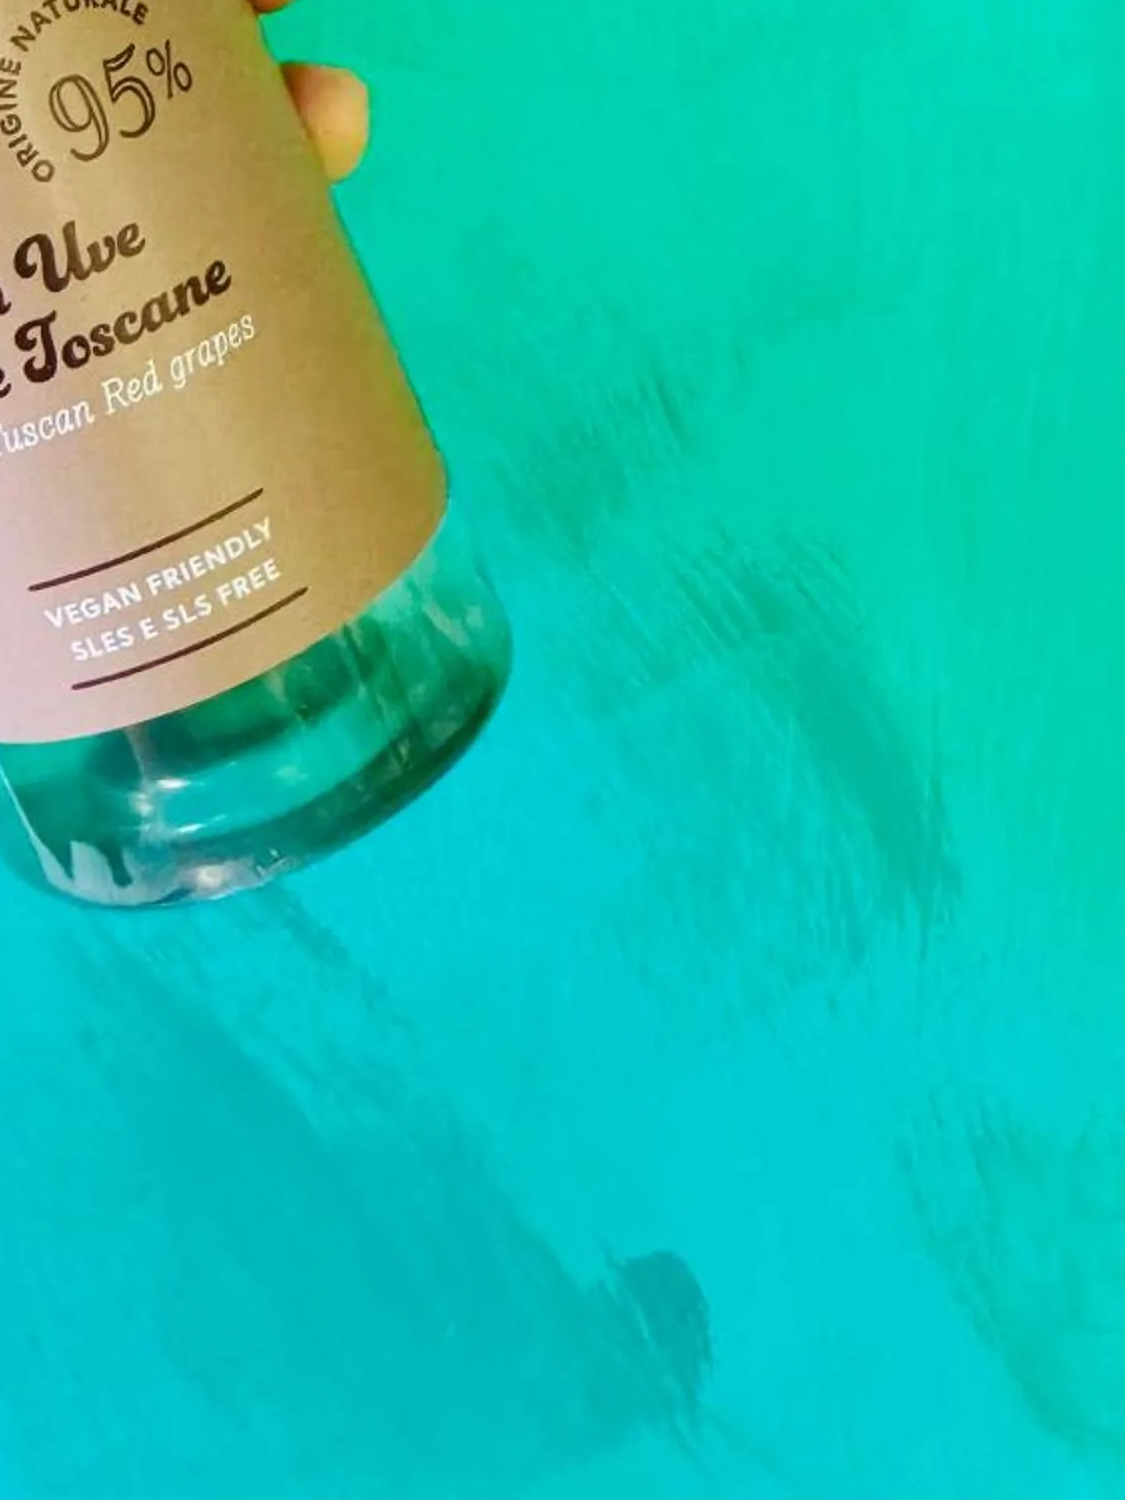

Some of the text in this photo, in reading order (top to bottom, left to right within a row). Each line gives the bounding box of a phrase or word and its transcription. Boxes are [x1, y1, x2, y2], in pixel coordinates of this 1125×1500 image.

[48, 39, 192, 162] 95%
[14, 221, 146, 292] Uve
[15, 259, 232, 383] Toscane
[101, 360, 162, 414] Red
[170, 314, 255, 388] grapes
[44, 518, 273, 629] VEGAN FRIENDLY
[71, 559, 282, 661] SLES E SLS FREE
